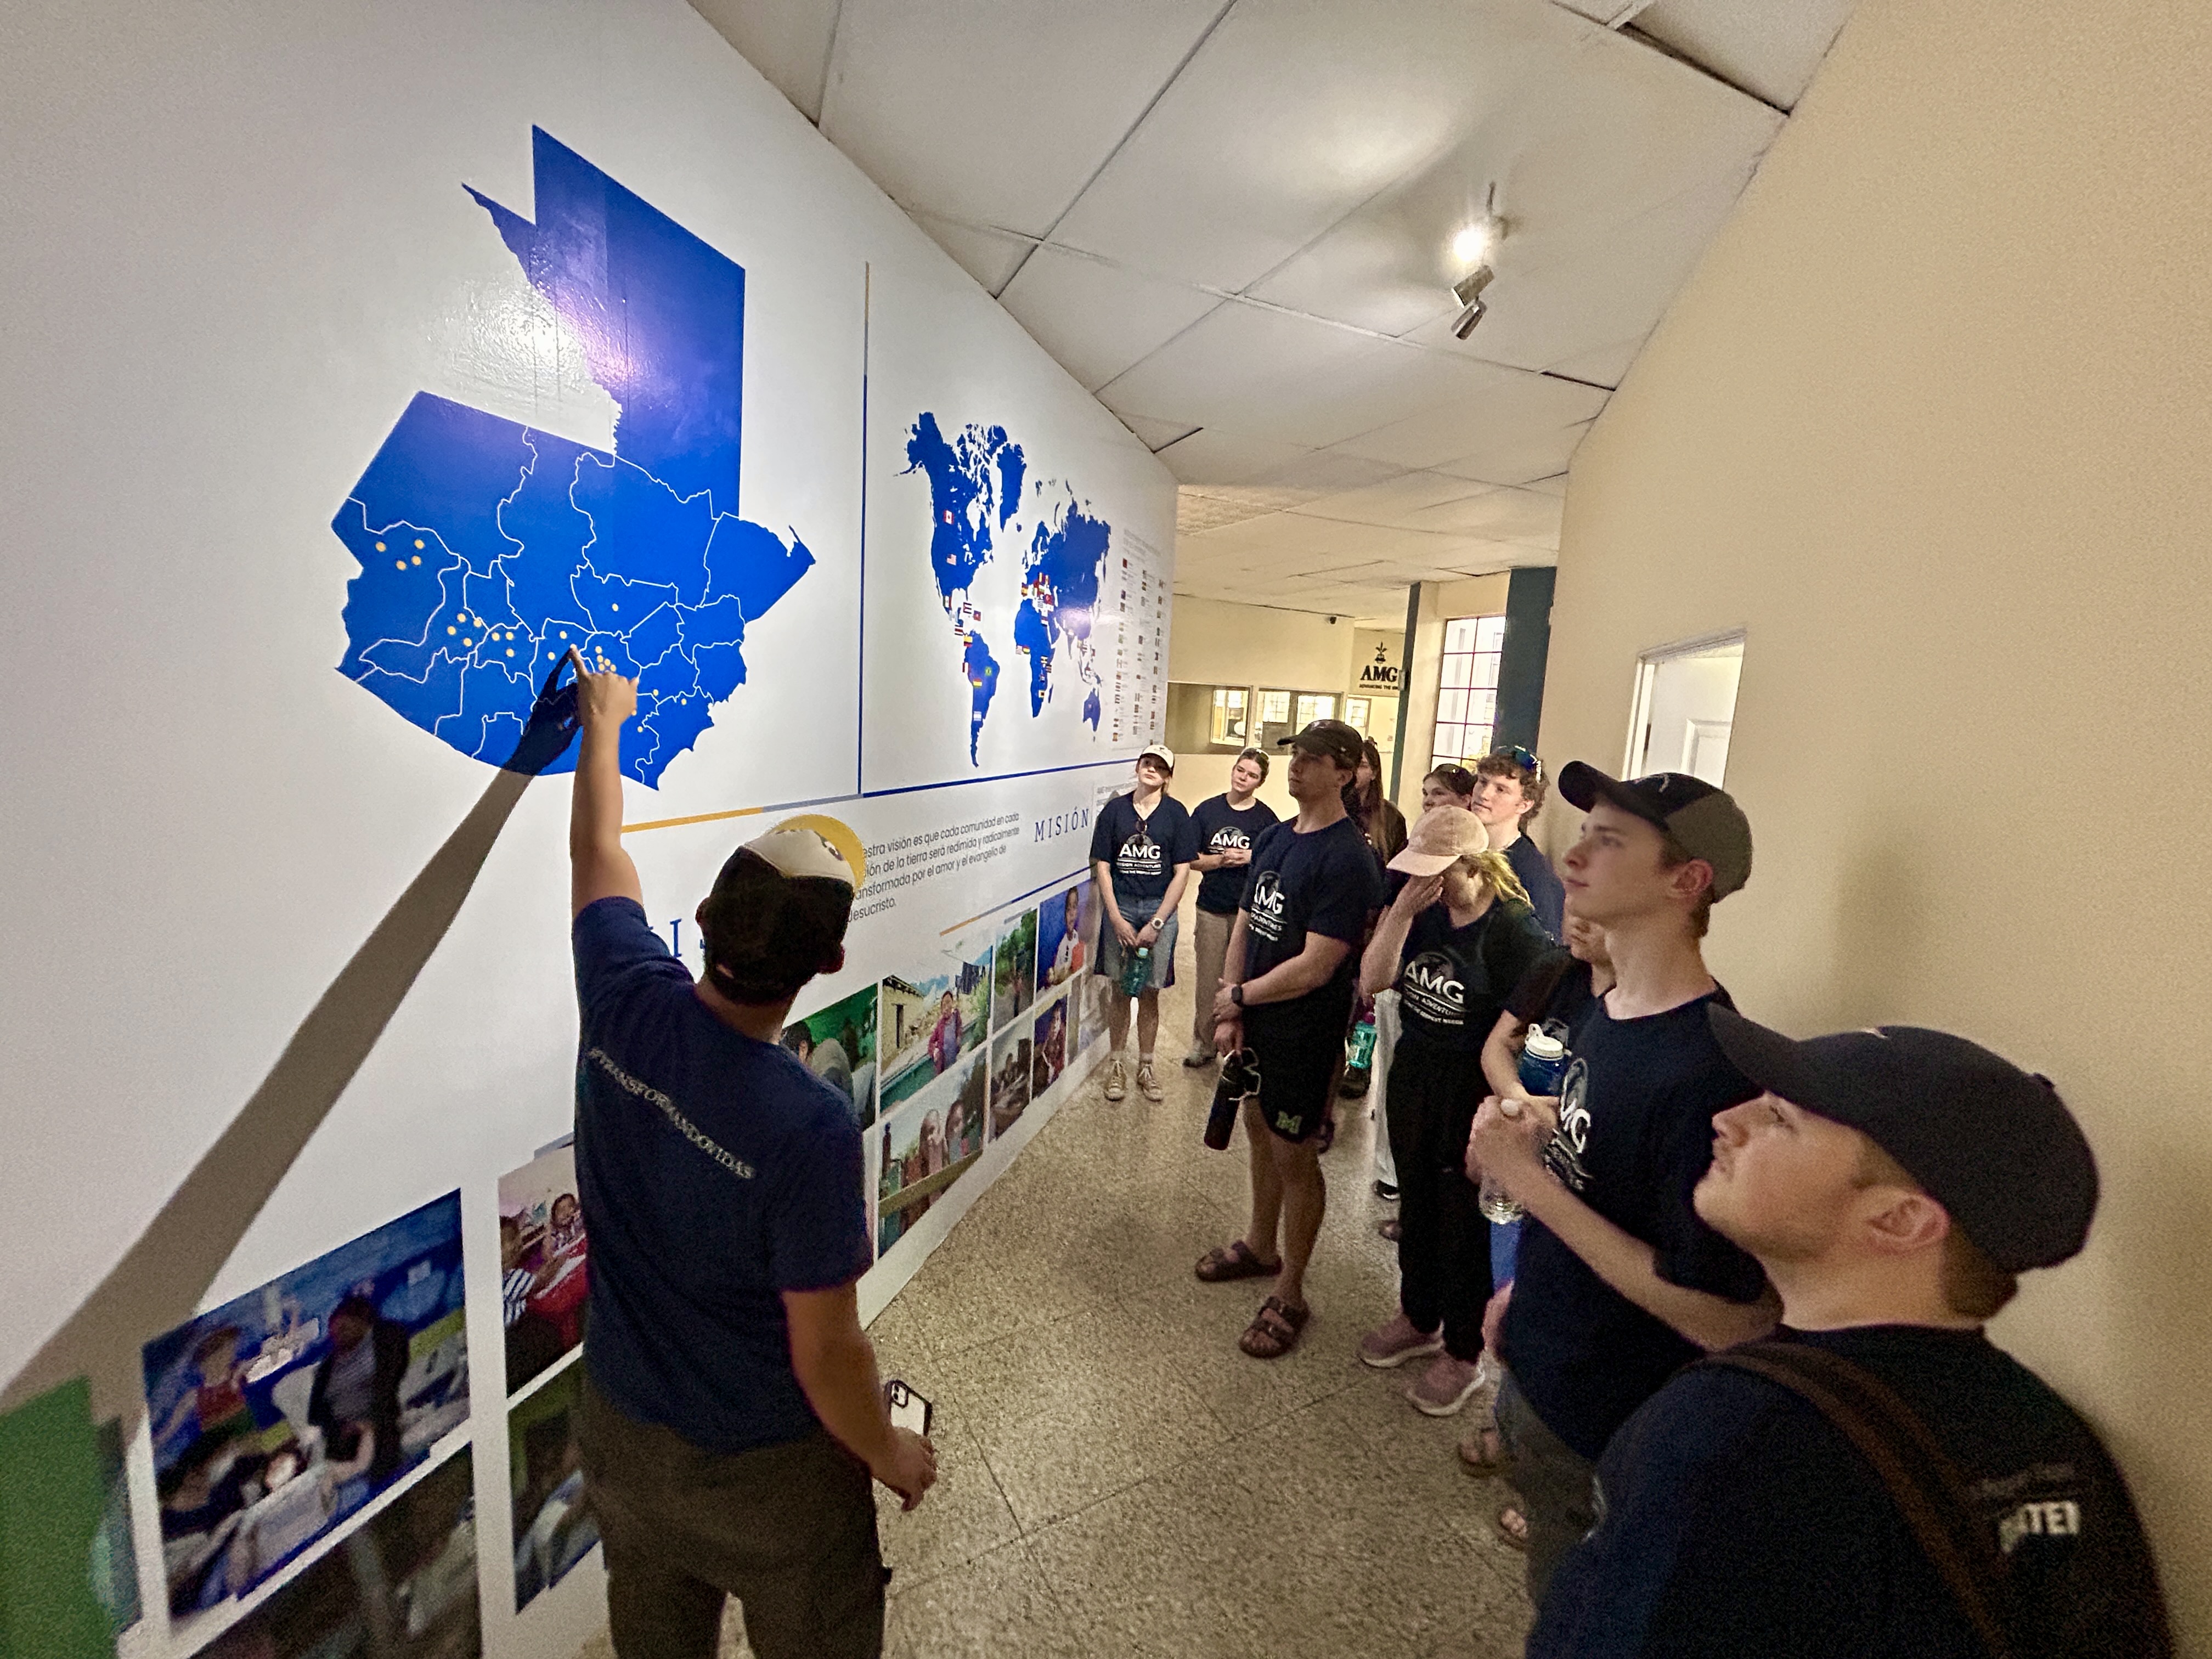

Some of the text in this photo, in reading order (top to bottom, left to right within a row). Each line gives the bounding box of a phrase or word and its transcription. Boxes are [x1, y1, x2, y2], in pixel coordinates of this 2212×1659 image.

[1360, 665, 1398, 682] AMG
[864, 812, 1019, 859] estra visión es que cada comunidad en cada
[1035, 806, 1088, 842] MISIÓN
[1211, 833, 1250, 849] AMG
[883, 859, 895, 873] de
[896, 856, 905, 868] la
[906, 851, 927, 866] tierra
[947, 837, 977, 854] redimida
[978, 837, 982, 850] y
[983, 827, 1019, 845] radicalmente
[1119, 843, 1161, 860] AMG
[855, 844, 1007, 900] ansformada por el amor y el evangelio de
[1404, 961, 1464, 1004] AMG
